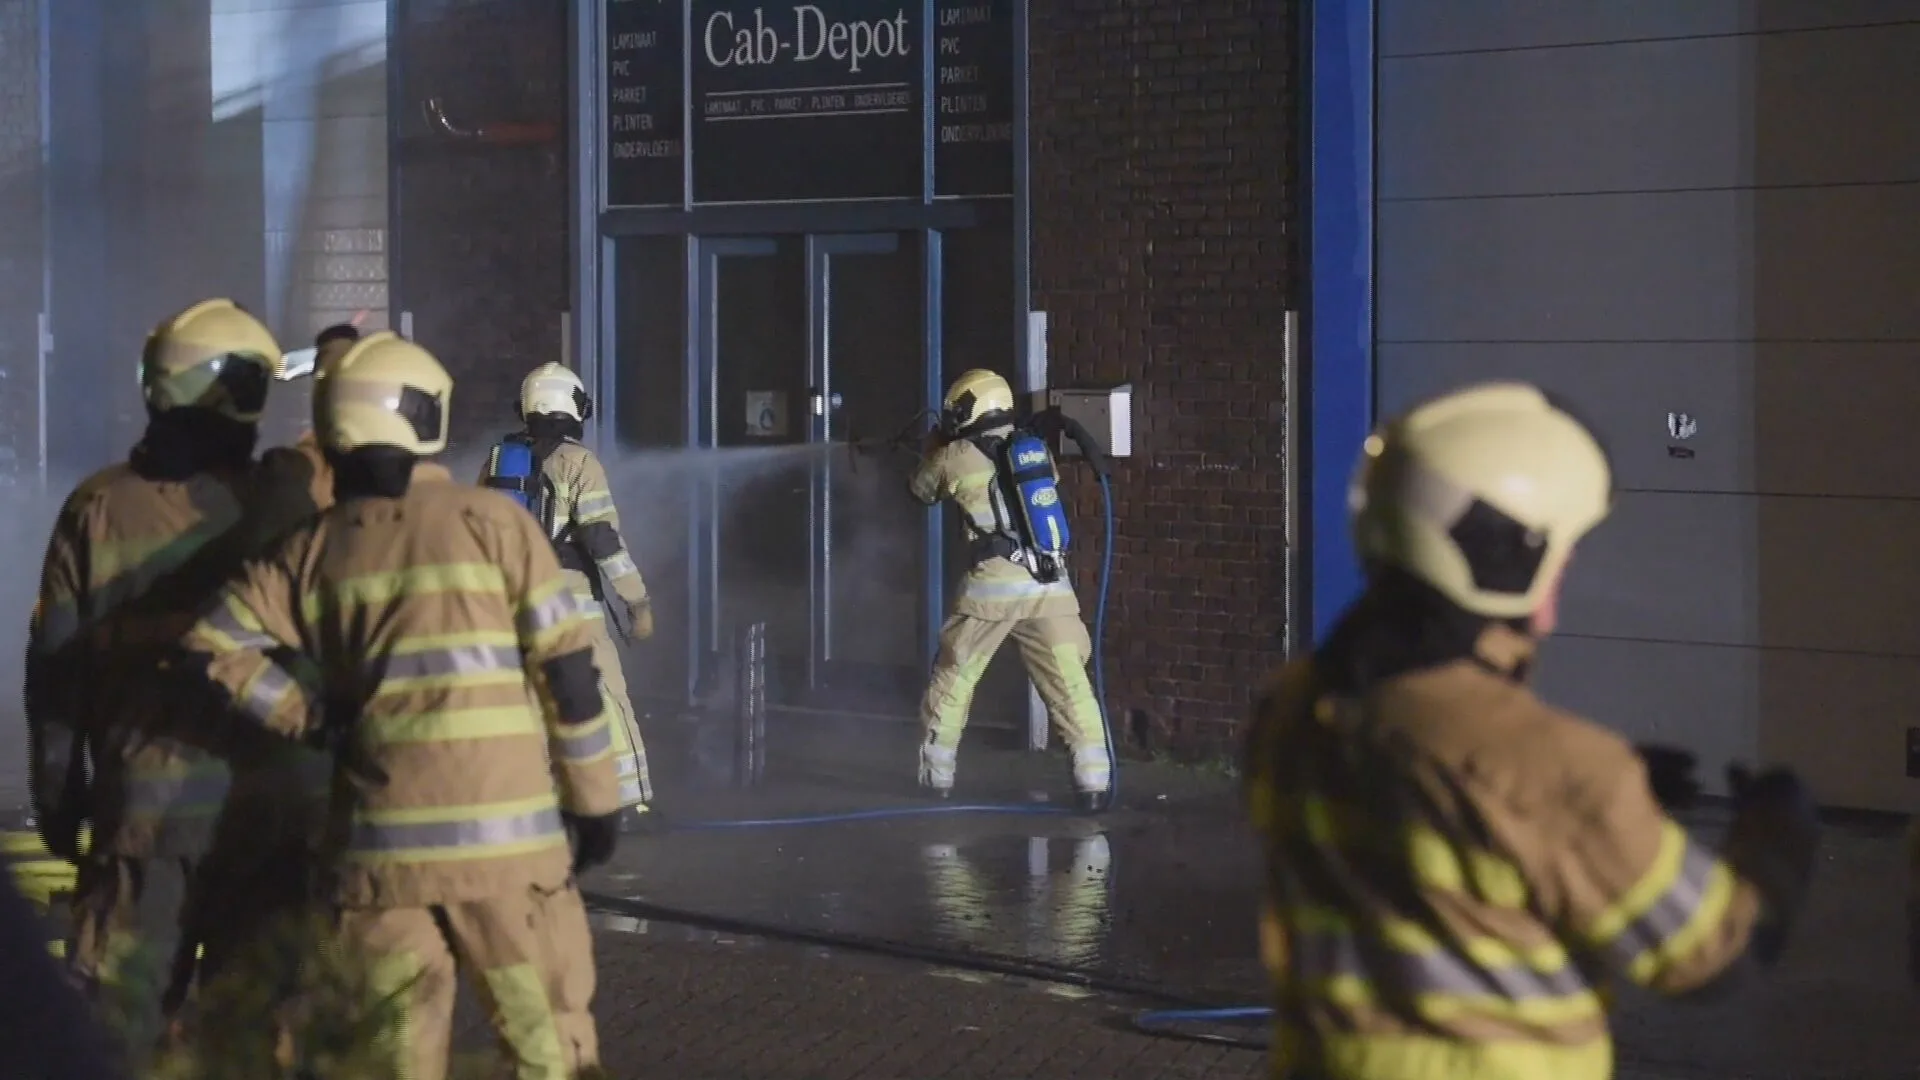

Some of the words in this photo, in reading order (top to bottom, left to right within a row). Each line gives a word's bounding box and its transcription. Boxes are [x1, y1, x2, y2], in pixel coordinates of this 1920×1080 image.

[704, 5, 911, 73] Cab-Depot
[940, 37, 960, 55] PVC
[612, 60, 630, 77] PVC
